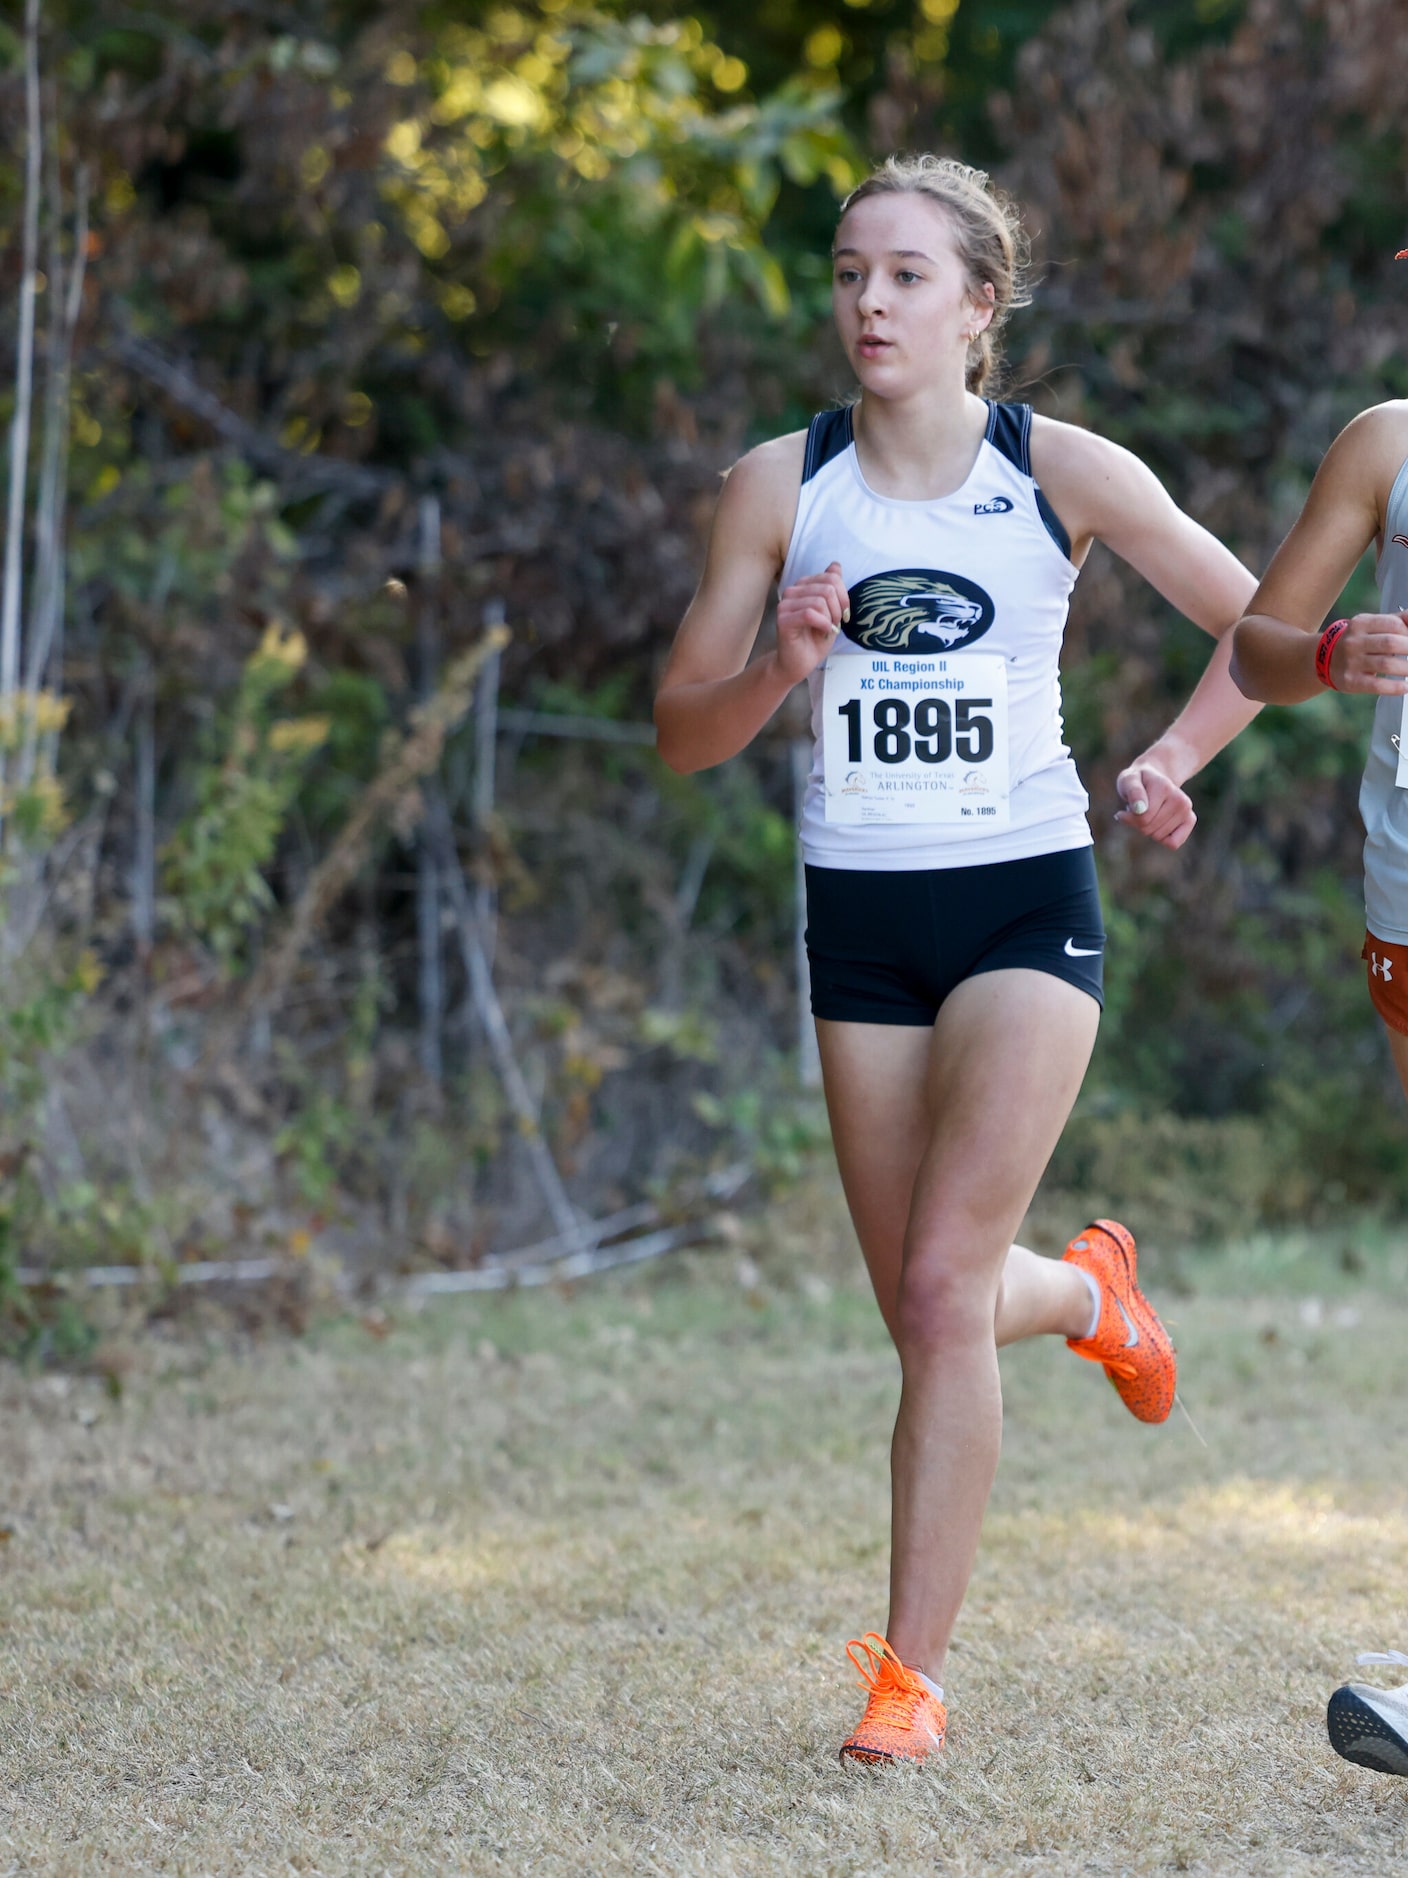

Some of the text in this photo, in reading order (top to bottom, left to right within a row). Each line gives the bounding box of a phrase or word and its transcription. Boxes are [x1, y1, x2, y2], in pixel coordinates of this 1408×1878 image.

[872, 661, 890, 673] UIL
[894, 661, 935, 675] Region
[860, 678, 965, 692] XC Championship
[838, 698, 994, 764] 1895
[870, 771, 882, 779] The
[885, 771, 921, 782] University
[923, 771, 932, 779] of
[877, 781, 947, 791] ARLINGTON
[960, 807, 974, 816] No.
